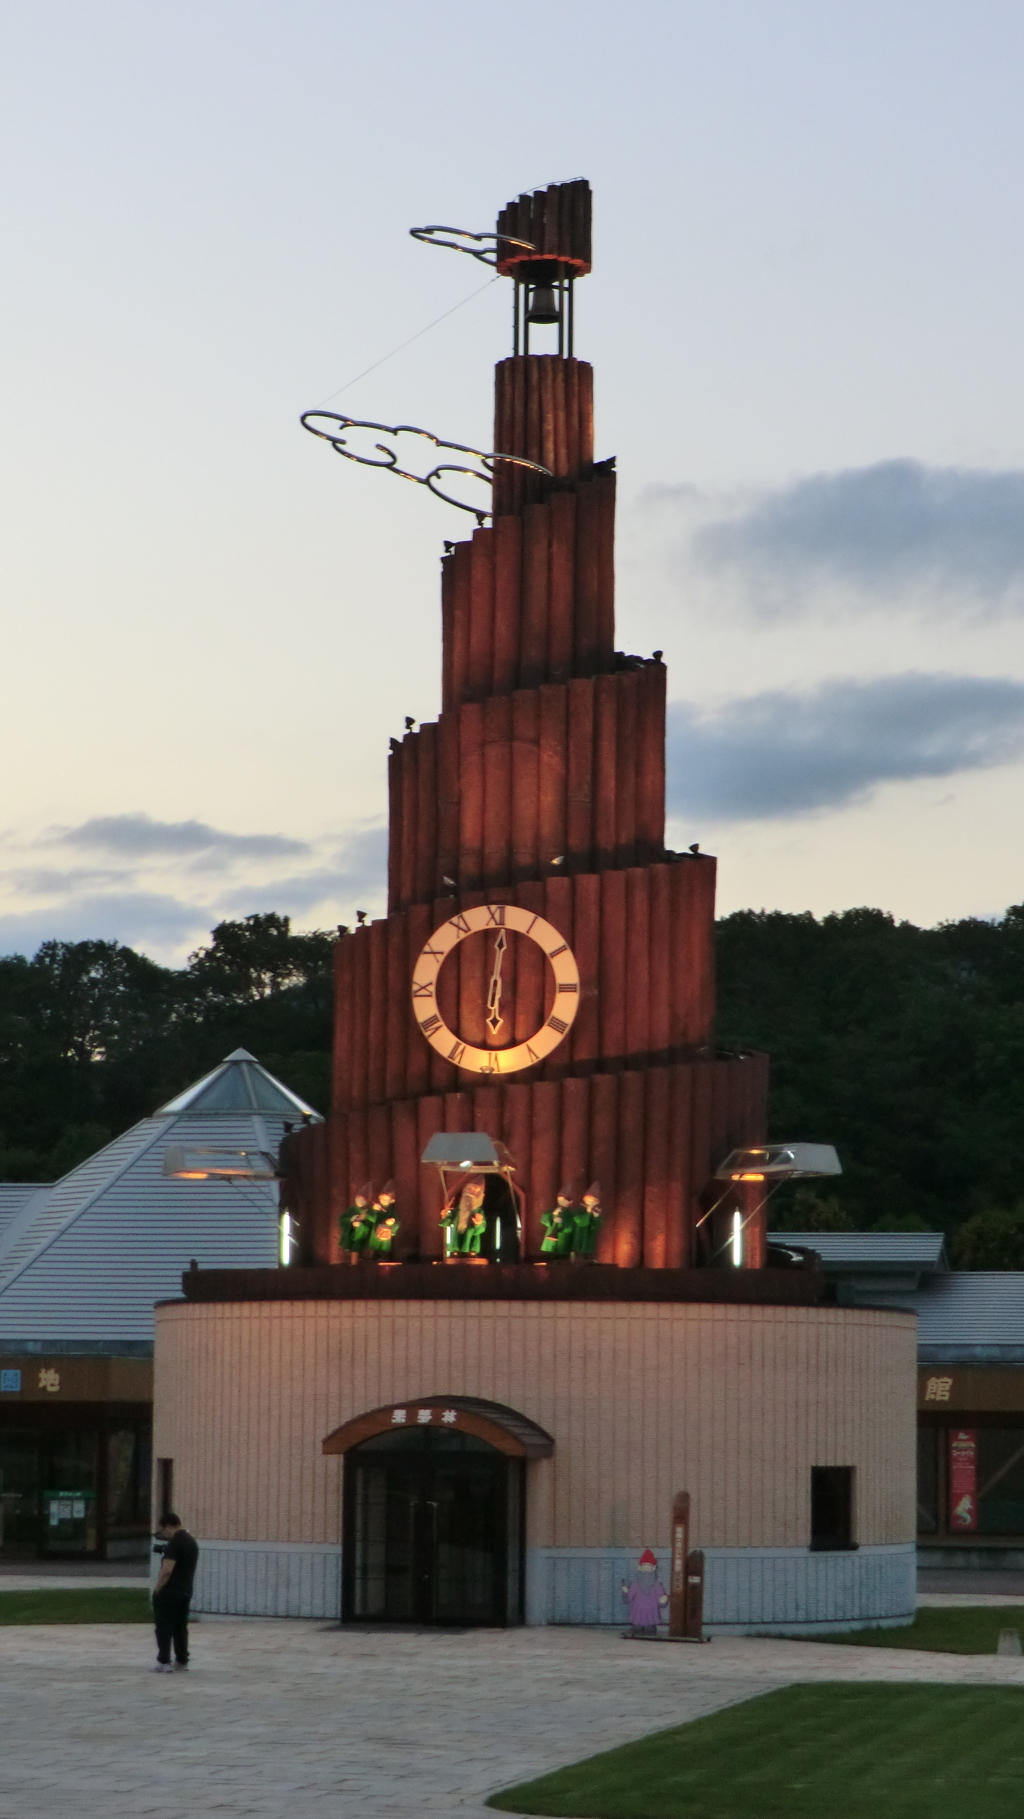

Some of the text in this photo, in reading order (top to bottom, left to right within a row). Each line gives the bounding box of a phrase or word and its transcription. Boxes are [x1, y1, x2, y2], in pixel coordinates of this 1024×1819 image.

[449, 914, 471, 938] XI
[486, 906, 506, 926] XII
[526, 916, 538, 934] I
[422, 942, 444, 963] X
[414, 981, 433, 998] IX
[526, 1043, 539, 1063] V
